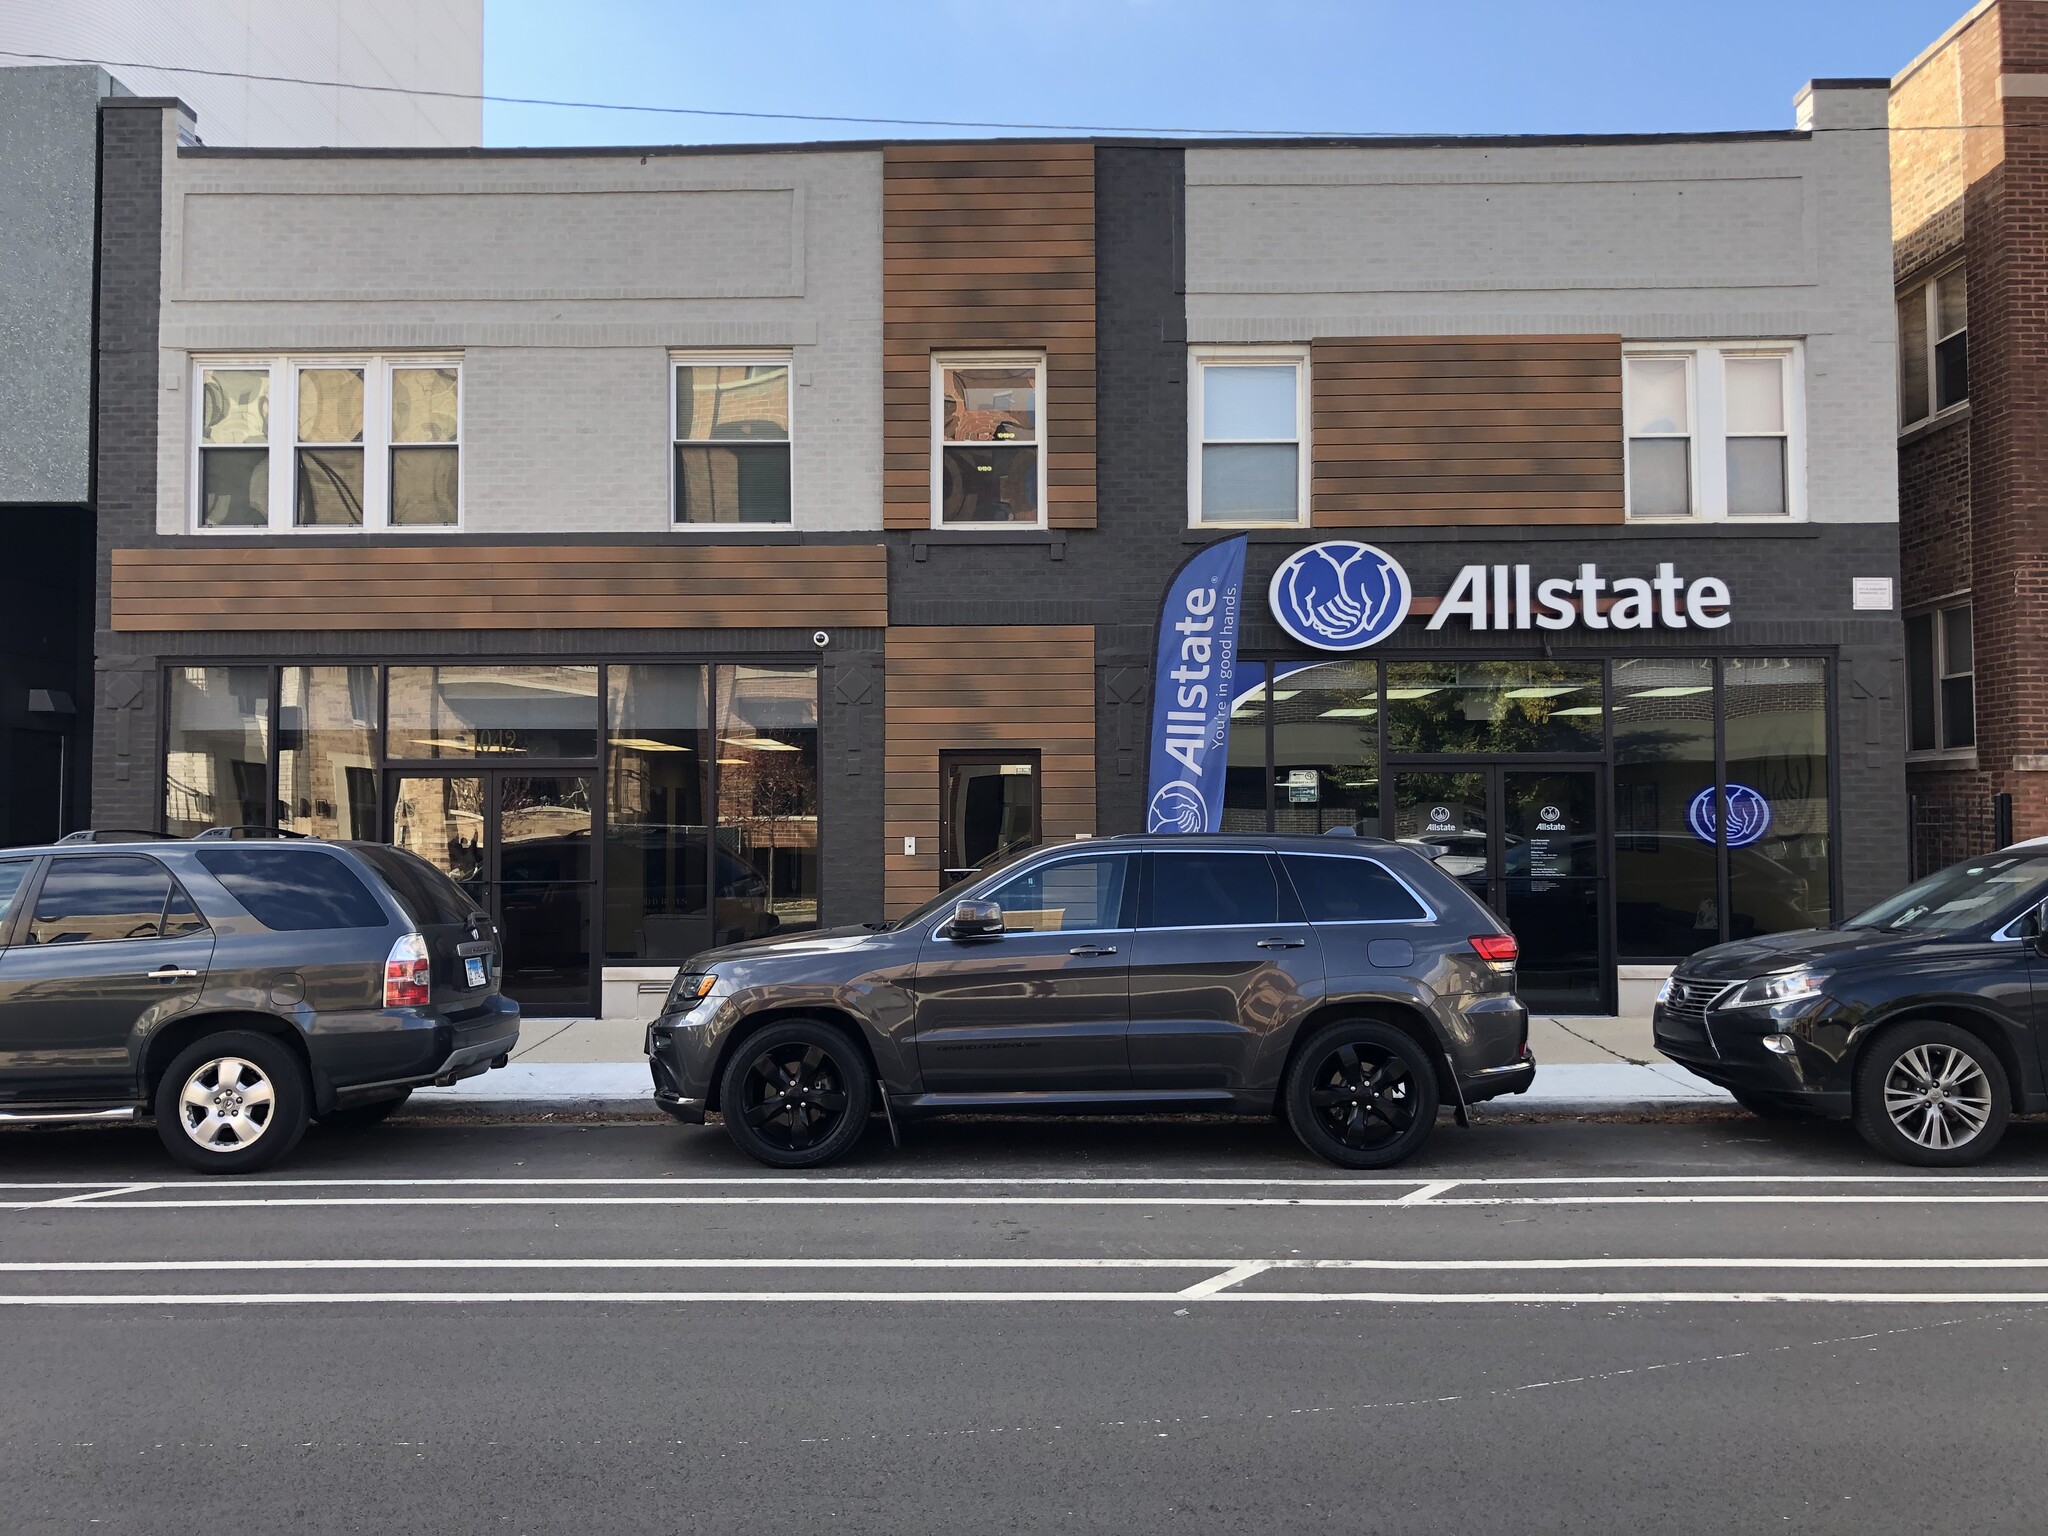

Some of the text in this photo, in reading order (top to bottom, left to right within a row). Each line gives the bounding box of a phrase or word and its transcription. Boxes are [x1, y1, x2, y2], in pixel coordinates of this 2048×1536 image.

[1425, 562, 1731, 631] Allstate
[1212, 583, 1237, 750] You're in good hands.
[1426, 823, 1456, 831] Allstate
[1536, 822, 1566, 831] Allstate
